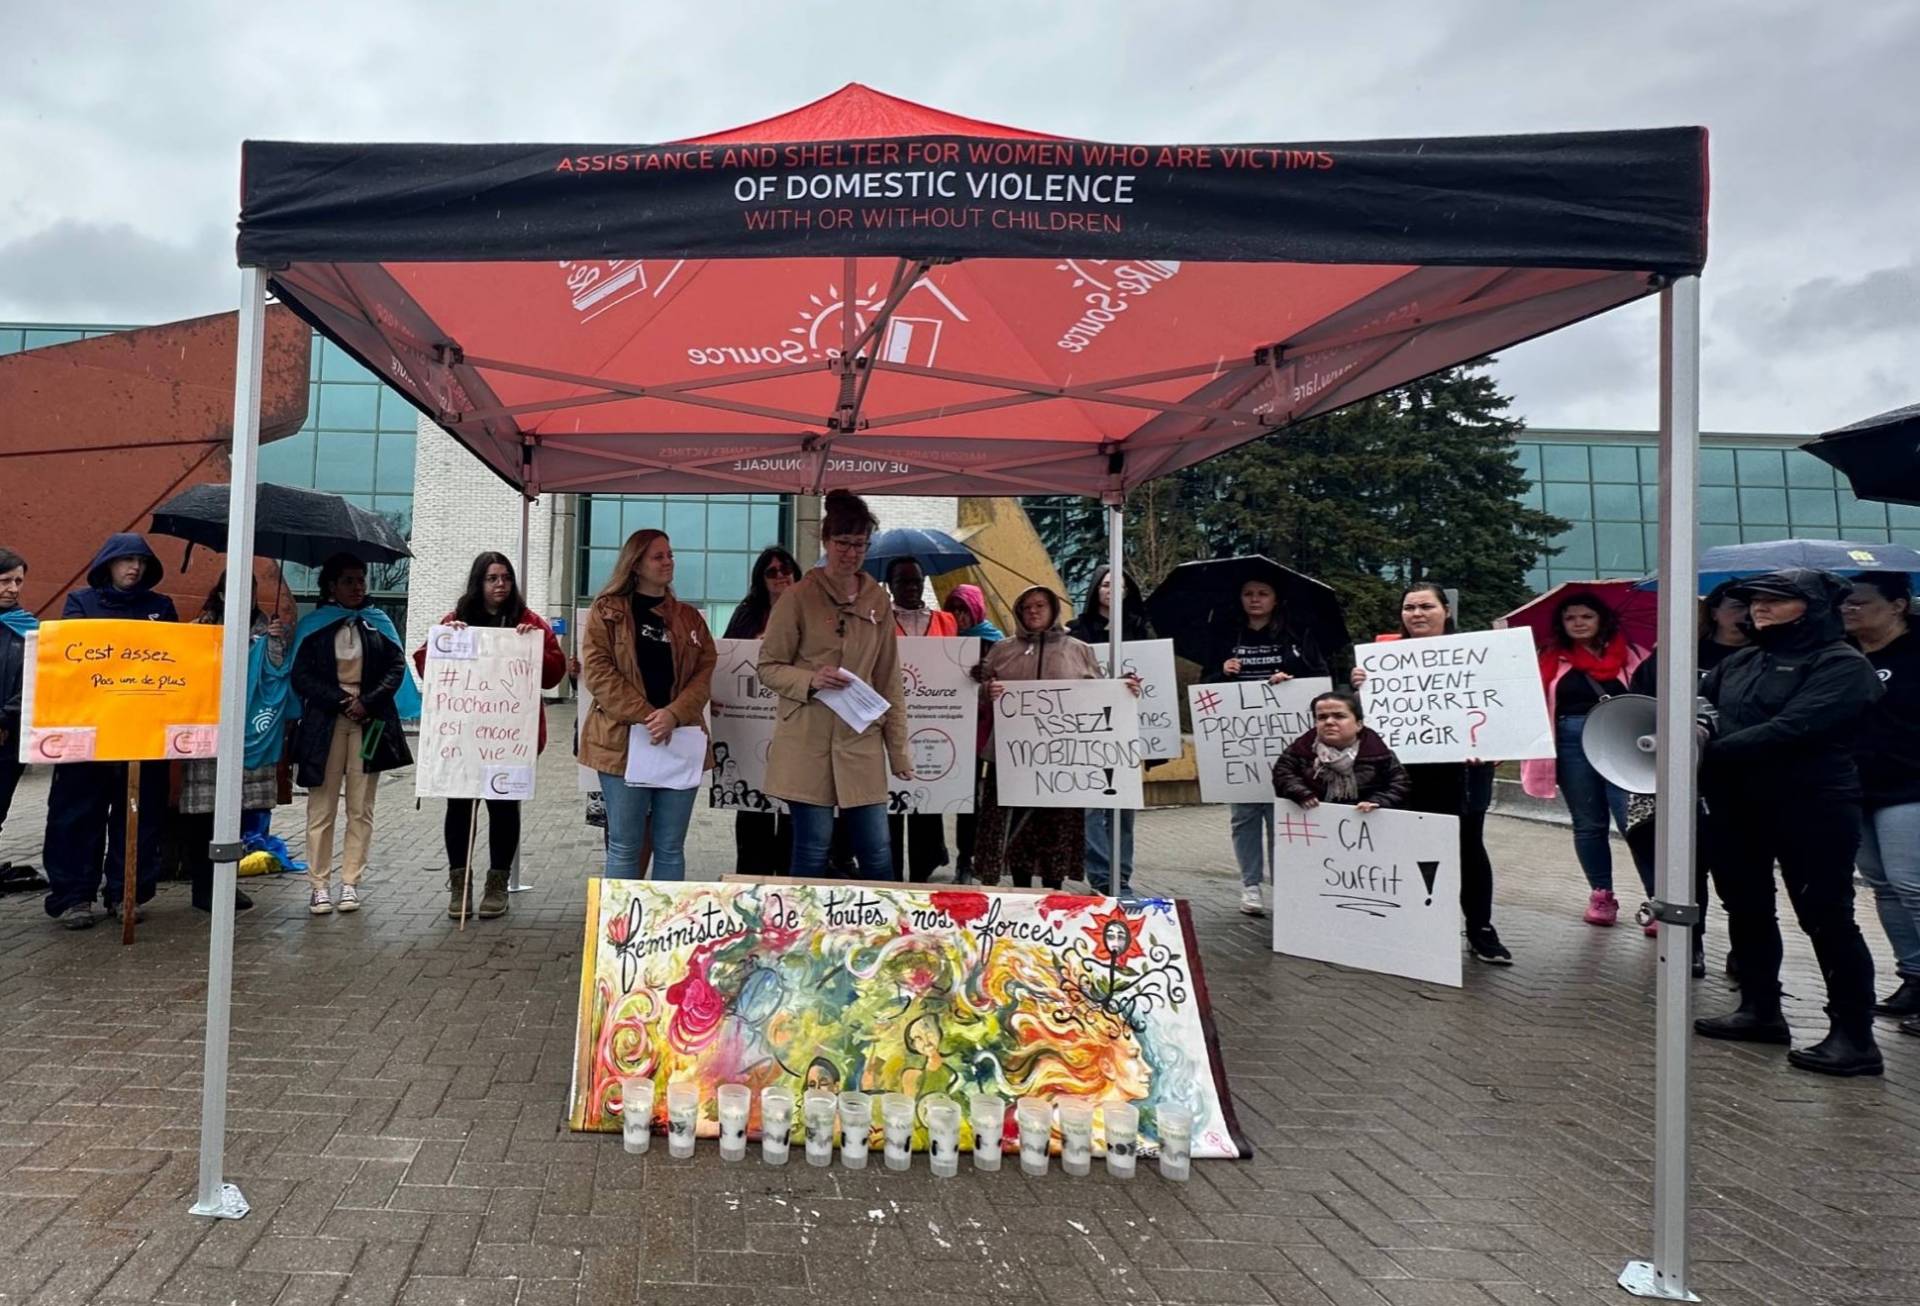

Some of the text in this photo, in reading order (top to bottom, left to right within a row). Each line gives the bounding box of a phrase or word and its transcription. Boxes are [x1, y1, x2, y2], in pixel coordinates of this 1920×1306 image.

[556, 143, 1336, 172] ASSISTANCE AND SHELTER FOR WOMEN WHO ARE VICTIMS
[734, 171, 1137, 204] OF DOMESTIC VIOLENCE
[744, 207, 1123, 234] WITH OR WITHOUT CHILDREN
[65, 642, 176, 664] C'est assez
[1363, 647, 1489, 673] COMBIEN
[91, 673, 115, 688] Pas
[141, 675, 156, 685] de
[158, 674, 186, 689] plus
[436, 693, 521, 716] Prochaine
[1000, 688, 1072, 719] C'EST
[1238, 683, 1281, 710] LA
[1369, 689, 1504, 715] MOURRIR
[439, 720, 521, 741] est encore
[1198, 711, 1315, 741] PROCHAIN
[1376, 714, 1436, 729] POUR
[440, 745, 463, 758] en
[1226, 761, 1261, 785] EN
[771, 893, 800, 929] de
[823, 890, 889, 927] toutes
[911, 907, 955, 929] nos
[972, 897, 1068, 966] forces
